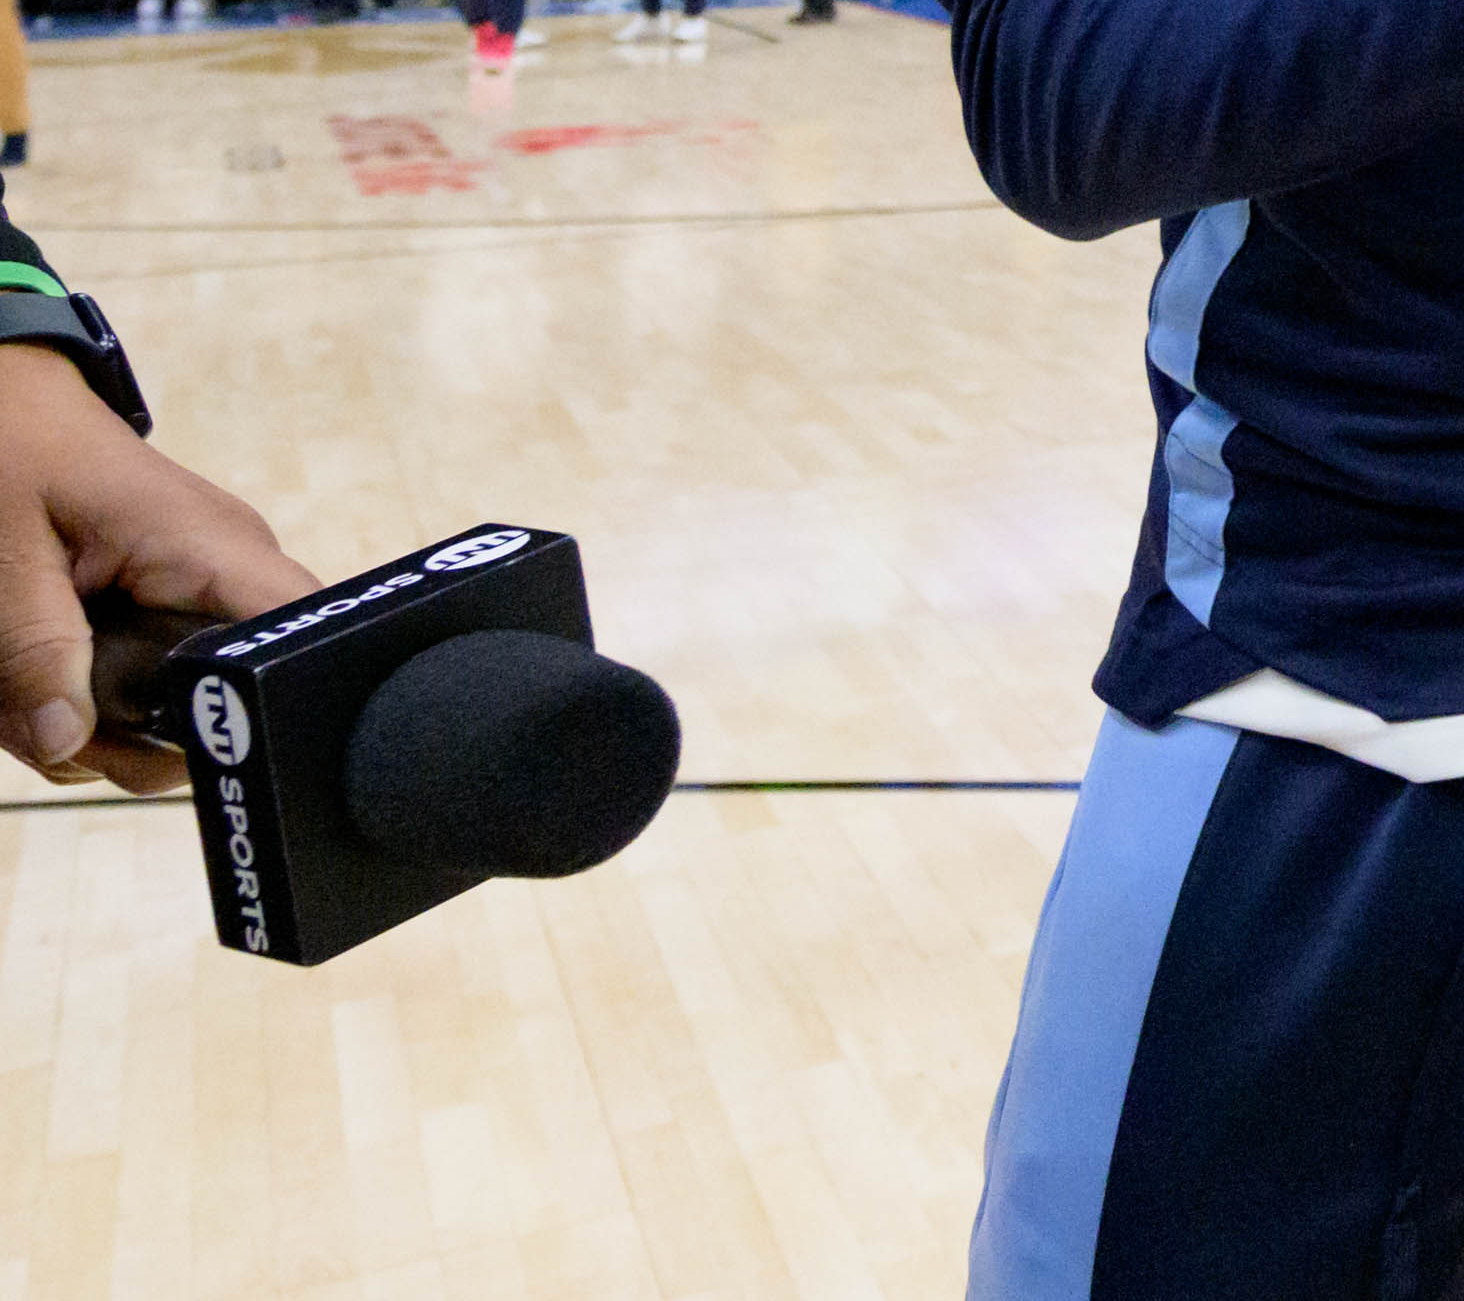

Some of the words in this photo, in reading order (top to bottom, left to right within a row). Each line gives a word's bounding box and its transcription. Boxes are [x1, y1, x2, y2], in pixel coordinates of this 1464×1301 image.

[424, 530, 531, 572] TNT
[215, 572, 425, 657] SPORTS
[198, 677, 243, 766] TNT
[219, 775, 269, 953] SPORTS
